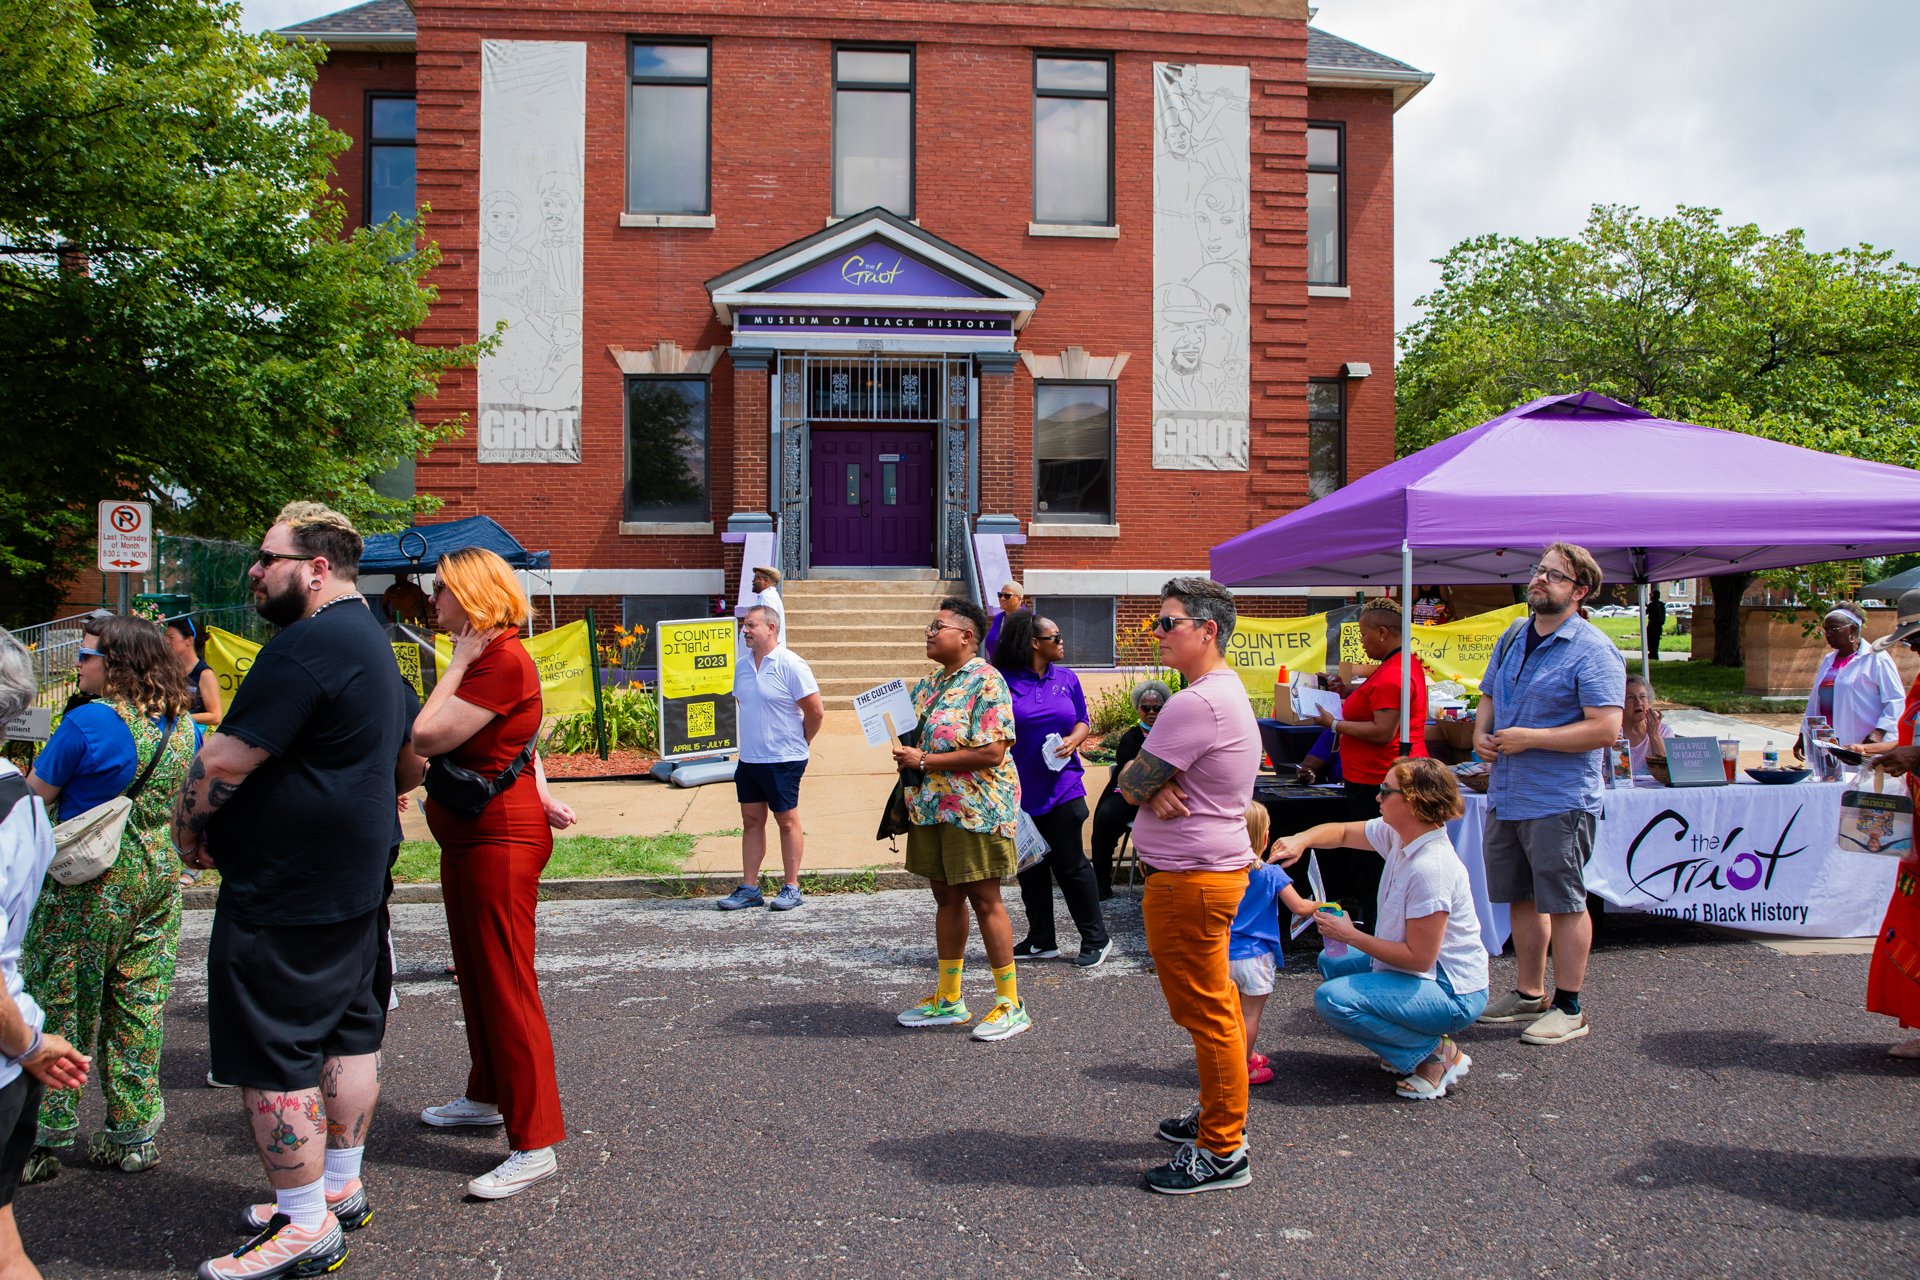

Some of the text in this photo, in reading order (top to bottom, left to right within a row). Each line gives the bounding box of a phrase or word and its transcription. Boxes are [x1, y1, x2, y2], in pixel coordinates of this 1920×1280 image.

[841, 255, 904, 286] Griot
[754, 316, 995, 329] MUSEUM OF BLACK HISTORY
[480, 410, 578, 449] GRIOT
[1155, 418, 1247, 456] GRIOT
[481, 449, 512, 459] MUSEUM
[513, 449, 522, 458] OF
[524, 449, 546, 458] BLACK
[120, 534, 147, 543] Thursday
[674, 628, 731, 641] COUNTER
[1227, 633, 1311, 649] OUNTER
[1475, 634, 1500, 642] GRIO
[664, 642, 710, 655] PUBLIC
[1458, 643, 1494, 651] MUSEUM
[534, 653, 560, 664] GRIOT
[697, 656, 725, 668] 2023
[1229, 651, 1275, 666] PUBL
[1459, 652, 1484, 661] BLACK
[555, 661, 568, 670] OF
[546, 668, 585, 681] HISTORY
[856, 693, 871, 705] THE
[871, 679, 903, 699] CULTURE
[673, 744, 692, 752] APRIL
[707, 740, 723, 749] JULY
[724, 739, 730, 747] 15
[1672, 751, 1680, 759] OF
[1691, 834, 1720, 852] the
[1624, 803, 1809, 902] Griot
[1682, 903, 1698, 921] of
[1703, 903, 1746, 922] Black
[1751, 902, 1809, 925] History
